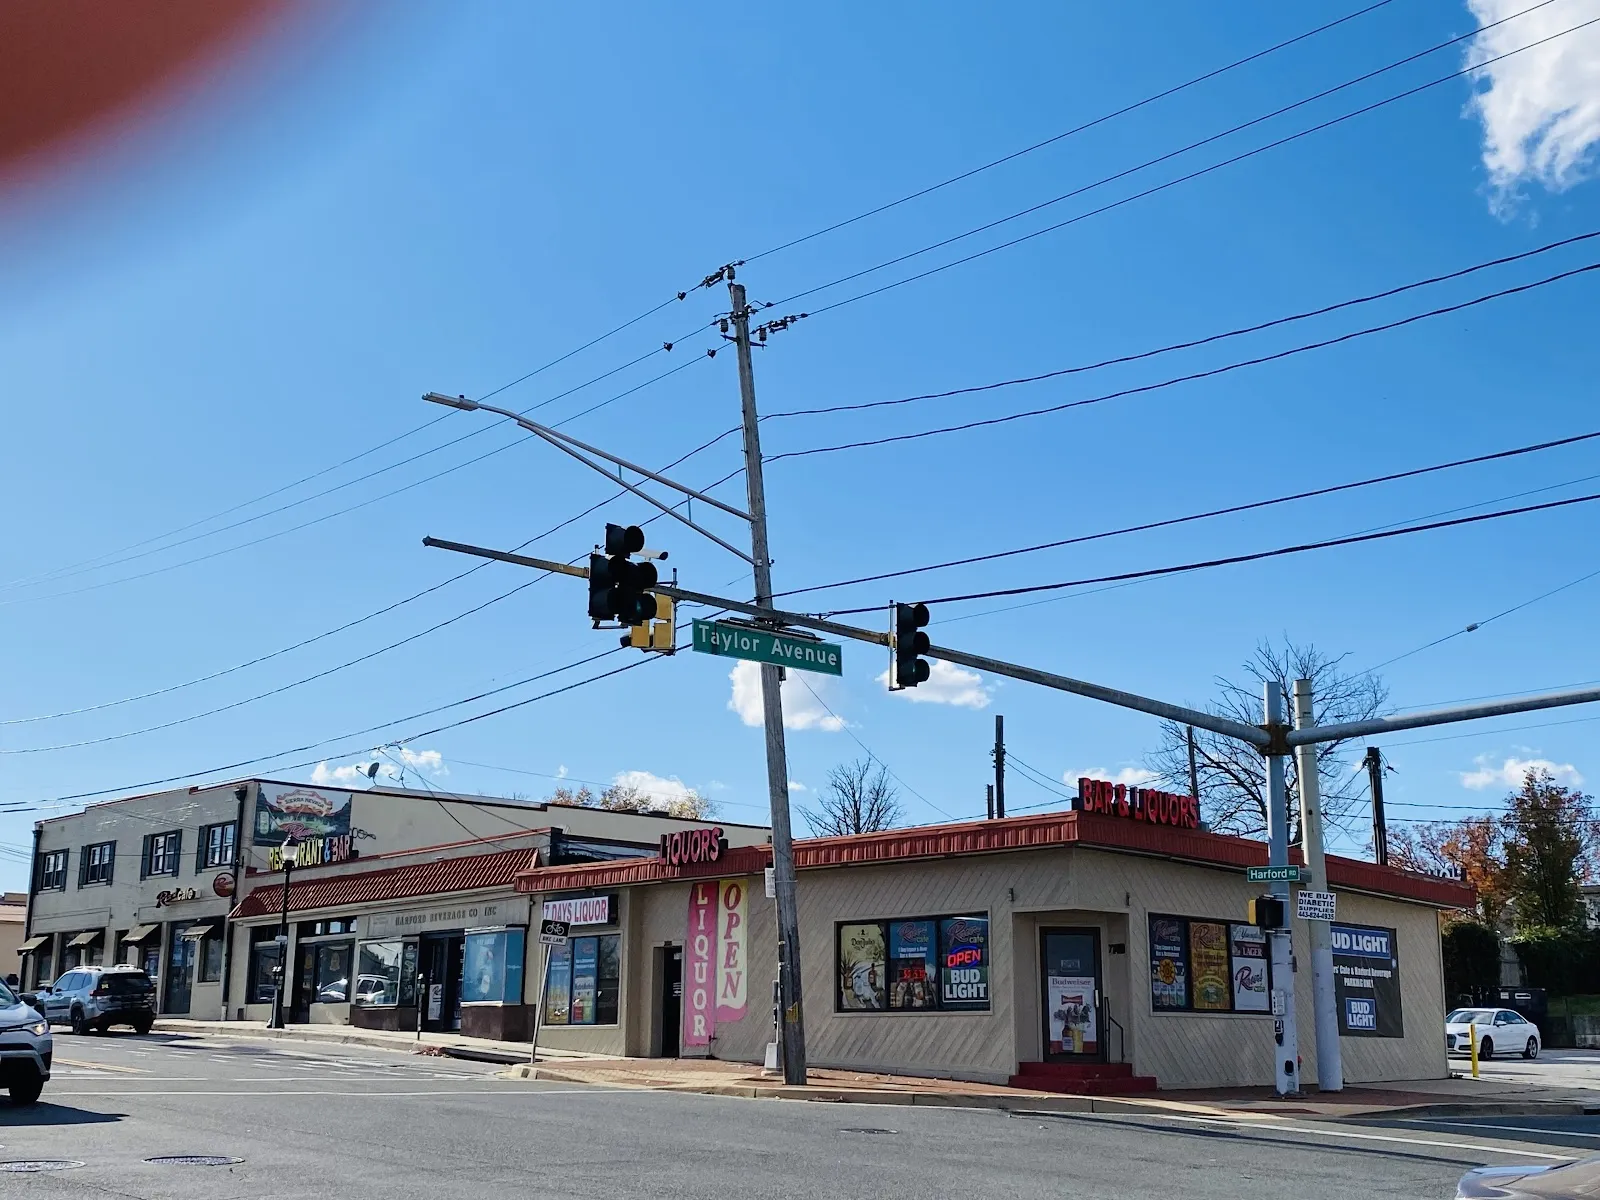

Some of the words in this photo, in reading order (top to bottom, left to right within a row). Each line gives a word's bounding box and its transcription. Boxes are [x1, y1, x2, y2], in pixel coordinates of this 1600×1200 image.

[698, 624, 760, 652] Taylor
[770, 639, 838, 666] Avenue
[1081, 777, 1114, 815] BAR
[1117, 783, 1130, 817] &
[1133, 787, 1198, 829] LIQUORS
[323, 836, 331, 863] &
[332, 835, 351, 862] BAR
[658, 827, 721, 867] LIQUORS
[1250, 868, 1288, 881] Harford
[1298, 899, 1335, 908] DIABETIC
[1316, 893, 1335, 901] BUY
[395, 914, 427, 926] HARFORD
[429, 910, 466, 923] BEVERAGE
[468, 908, 478, 918] CO
[484, 906, 498, 917] INC
[552, 902, 572, 925] DAYS
[574, 899, 608, 926] LIQUOR
[1298, 905, 1335, 914] SUPPLIES
[542, 935, 552, 943] BIKE
[721, 883, 743, 999] OPEN
[1331, 932, 1350, 950] UD
[1352, 933, 1388, 953] LIGHT
[692, 883, 710, 1037] LIQUOR
[947, 949, 981, 968] OPEN
[950, 969, 981, 984] BUD
[1051, 977, 1091, 986] Budweiser
[945, 983, 987, 1000] LIGHT
[1351, 1001, 1370, 1014] BUD
[1348, 1012, 1374, 1028] LIGHT
